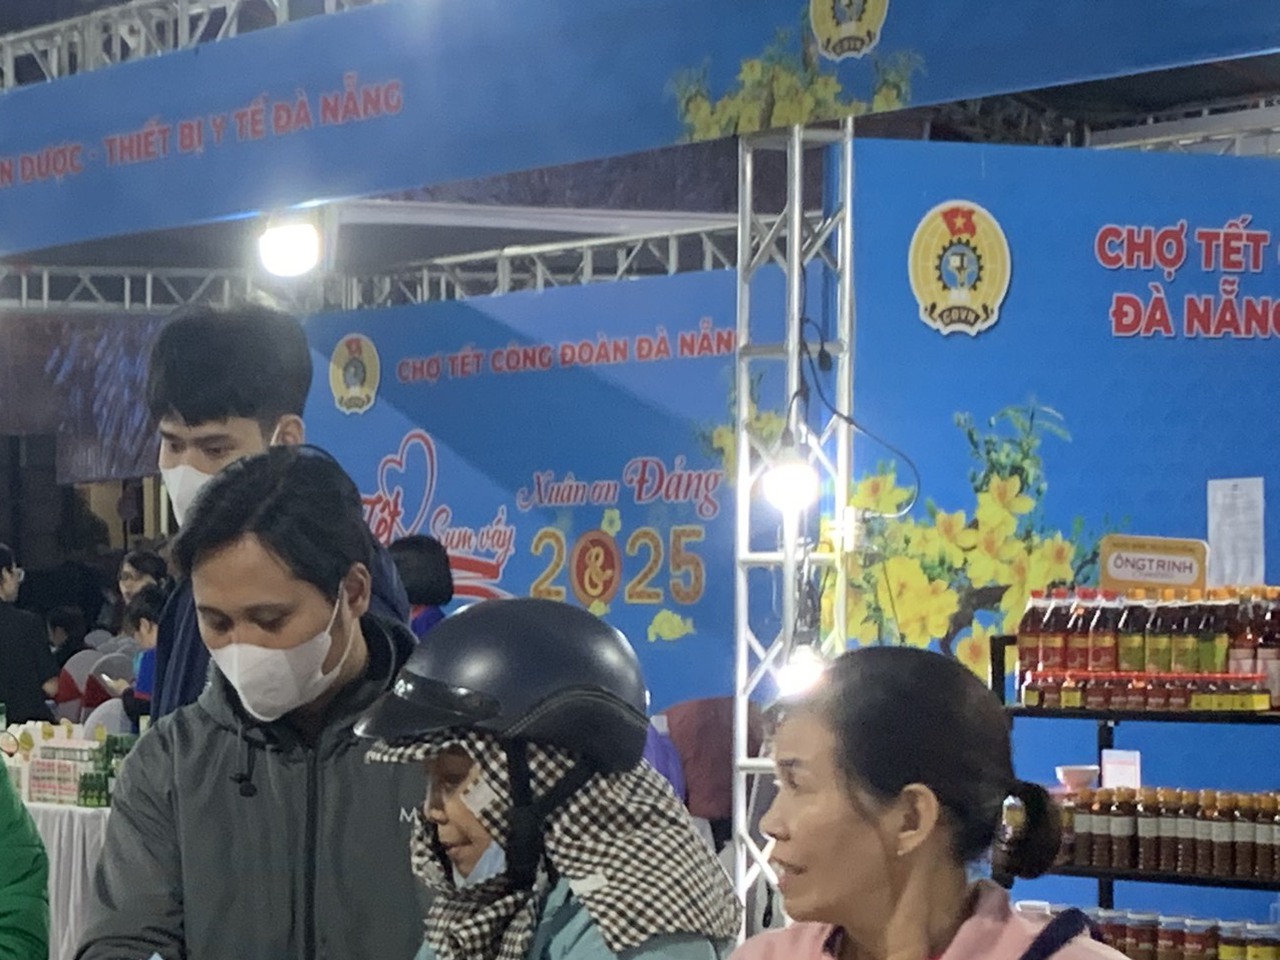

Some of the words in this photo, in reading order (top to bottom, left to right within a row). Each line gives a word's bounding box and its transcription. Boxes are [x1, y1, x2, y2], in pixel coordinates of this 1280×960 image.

[104, 115, 171, 166] THIẾT
[209, 114, 227, 144] Y
[234, 91, 267, 142] TẾ
[272, 87, 314, 136] ĐÀ
[1095, 219, 1188, 282] CHỢ
[1195, 214, 1270, 273] TẾT
[1109, 282, 1175, 337] ĐÀ
[397, 351, 443, 384] CHỢ
[447, 341, 485, 379] TẾT
[490, 338, 555, 374] CÔNG
[558, 330, 630, 368] ĐOÀN
[636, 325, 672, 362] ĐÀ
[678, 316, 738, 359] NẴN
[516, 469, 588, 512] Xuân
[623, 454, 723, 520] Đảng
